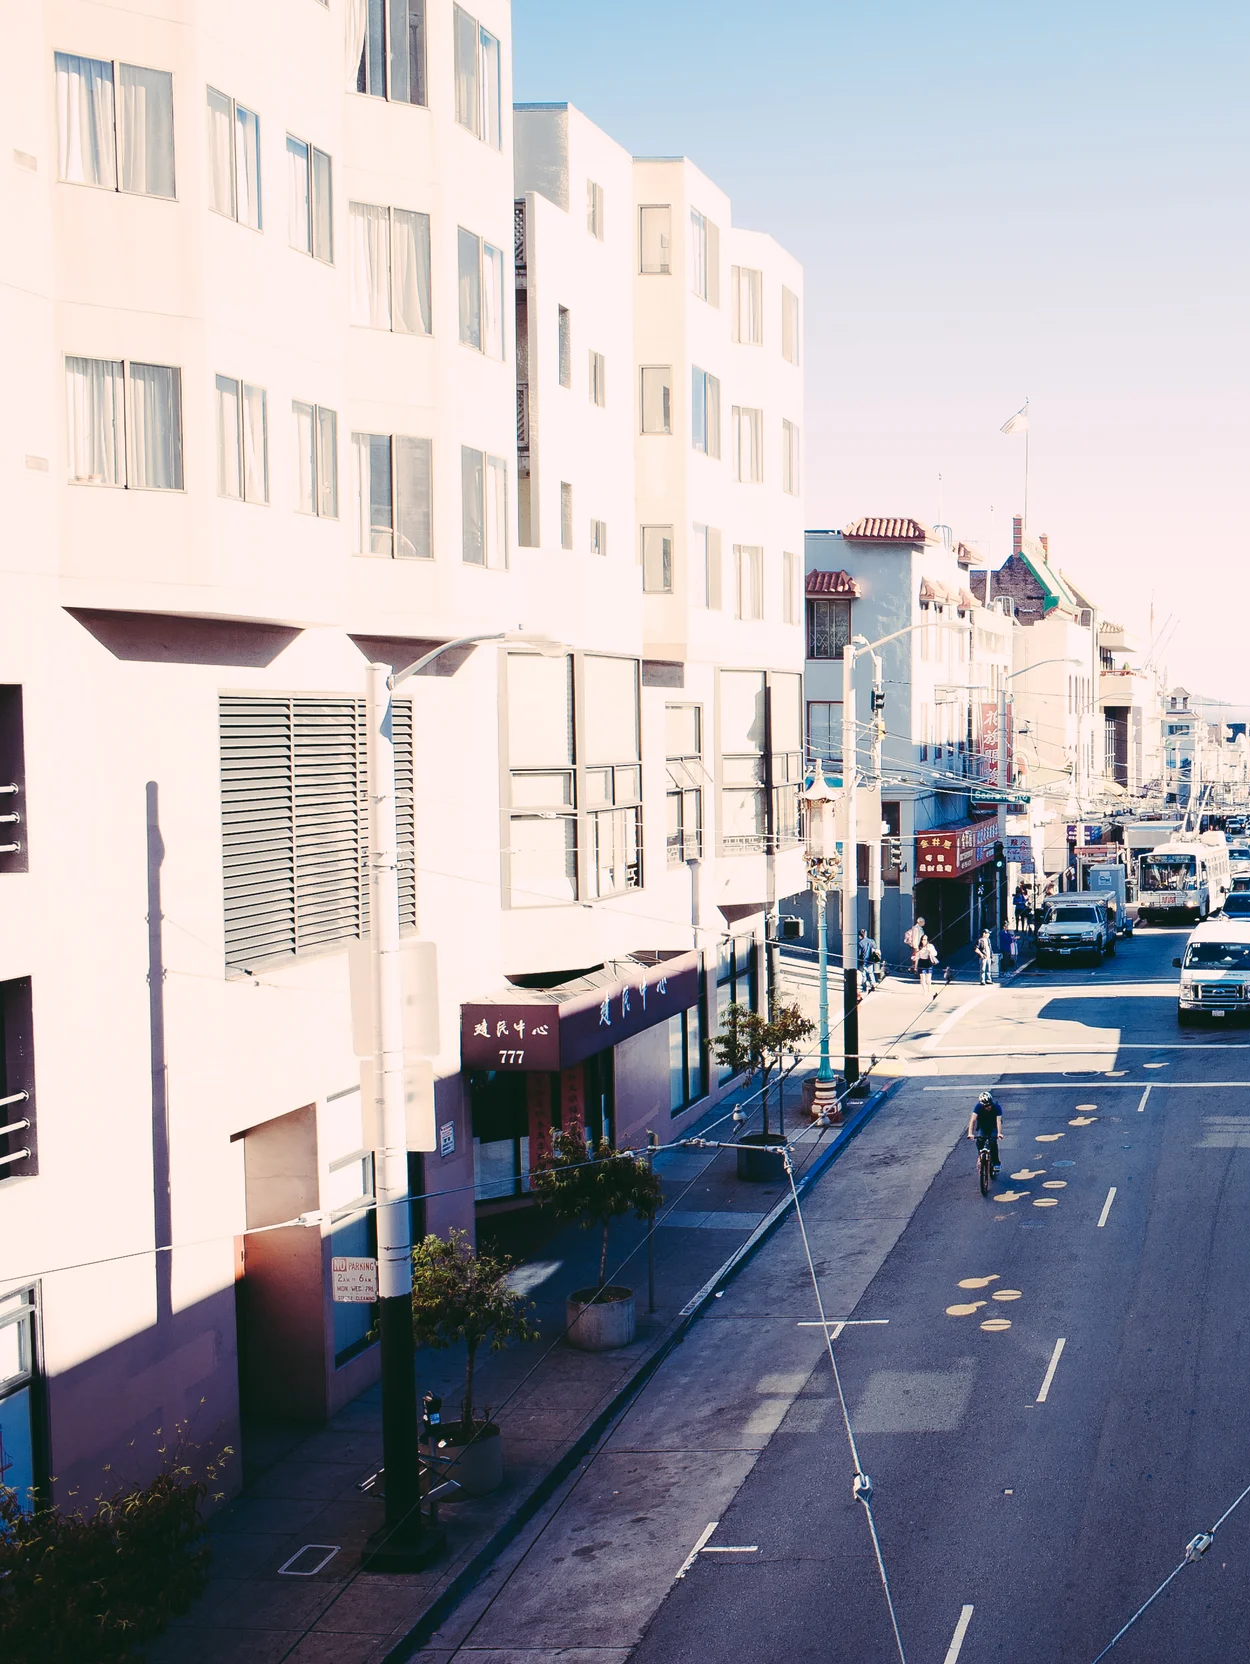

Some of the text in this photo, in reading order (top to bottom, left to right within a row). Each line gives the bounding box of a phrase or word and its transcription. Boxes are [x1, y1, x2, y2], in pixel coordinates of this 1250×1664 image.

[975, 790, 1027, 800] Sacrmnto
[499, 1050, 525, 1064] 777
[334, 1258, 374, 1271] NO PARKING
